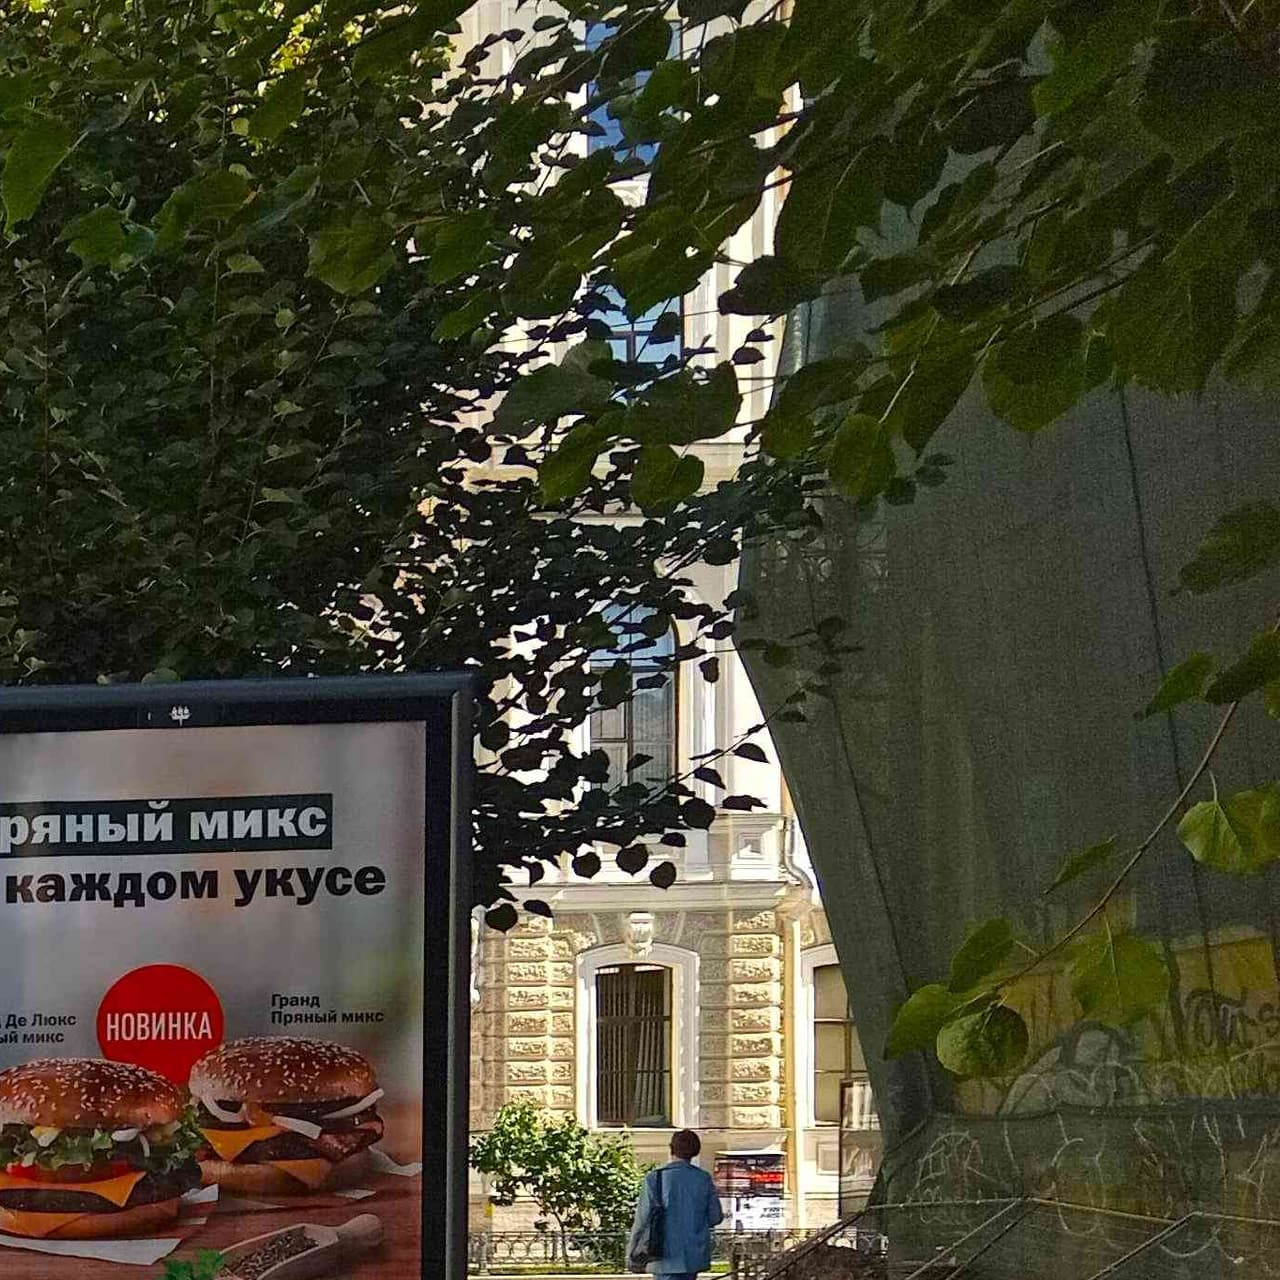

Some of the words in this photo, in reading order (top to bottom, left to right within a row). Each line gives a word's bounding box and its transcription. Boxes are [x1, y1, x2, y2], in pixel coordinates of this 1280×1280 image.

[189, 806, 328, 842] микс
[5, 868, 219, 908] каждом
[233, 864, 387, 906] укусе
[271, 993, 321, 1010] Гранд
[5, 1014, 28, 1030] Де
[31, 1013, 77, 1027] Люкс
[271, 1007, 338, 1026] Пряный
[341, 1009, 385, 1023] микс
[105, 1011, 214, 1043] НОВИНКА
[22, 1031, 65, 1044] микс
